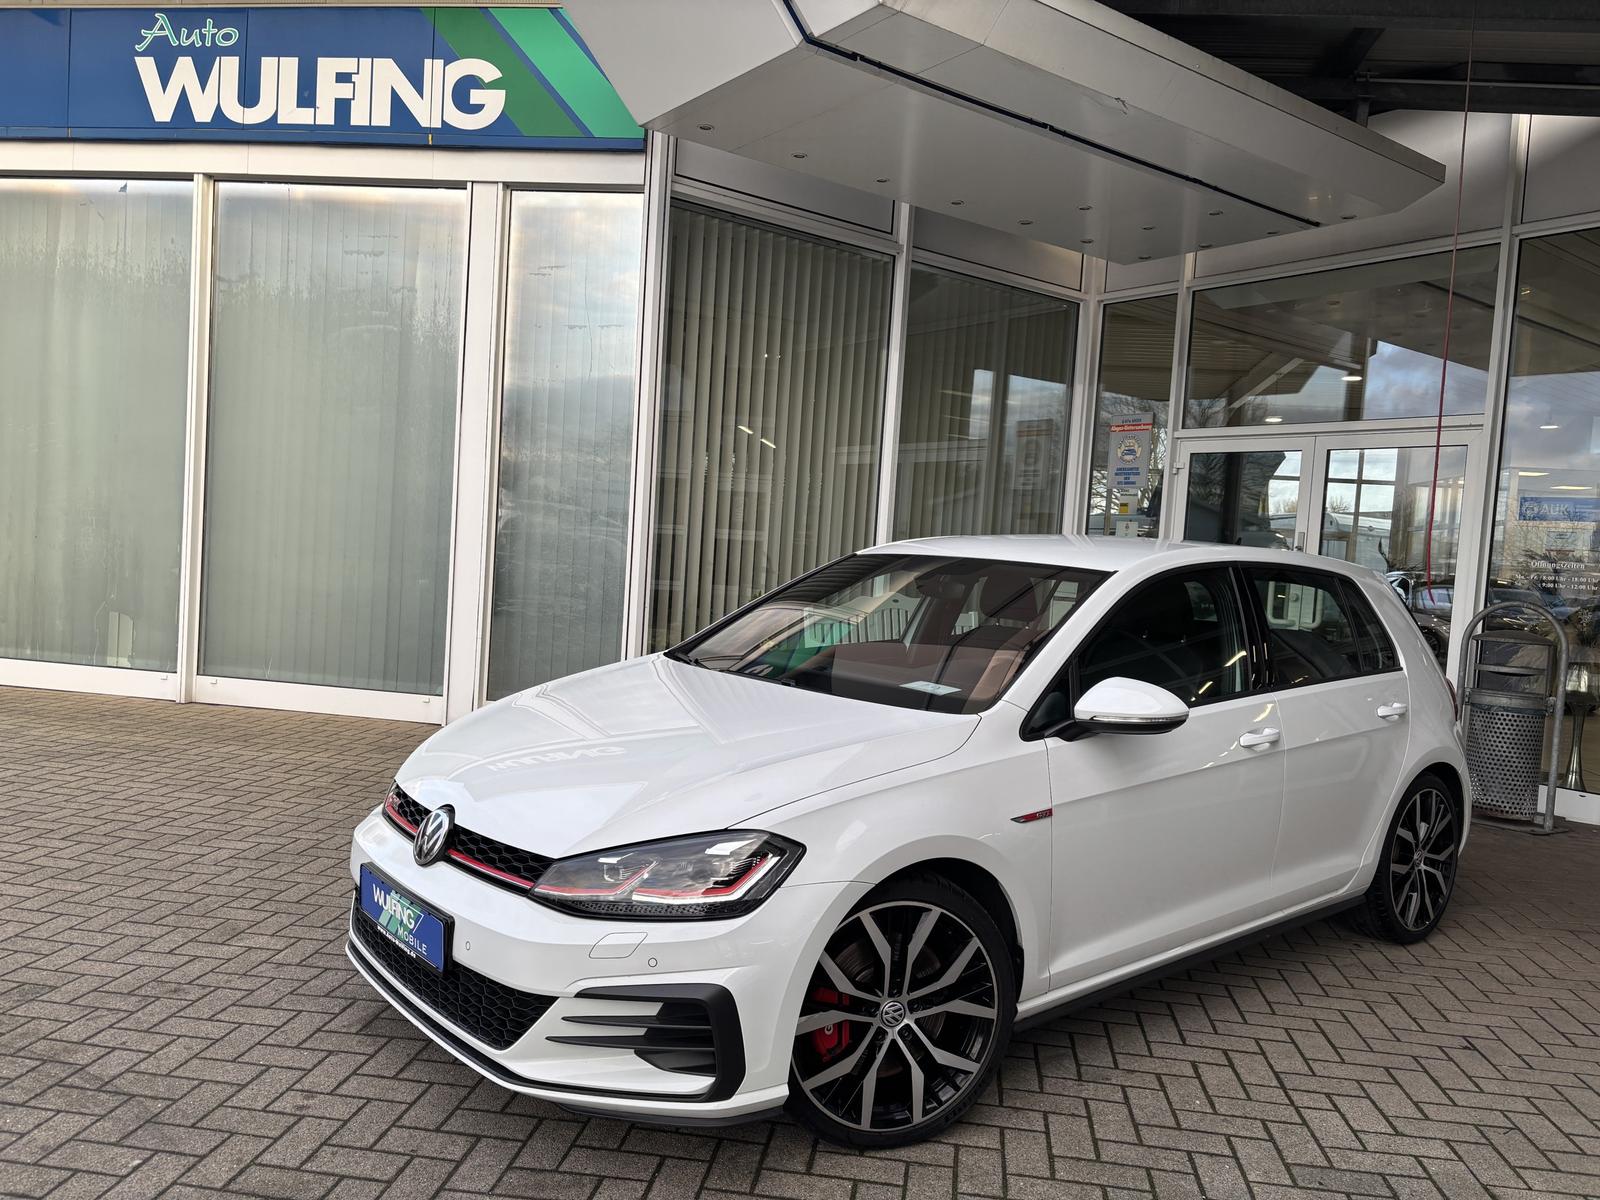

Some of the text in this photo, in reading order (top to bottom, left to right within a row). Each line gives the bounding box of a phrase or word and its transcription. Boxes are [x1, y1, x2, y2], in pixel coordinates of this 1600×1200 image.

[134, 12, 240, 52] Auto
[133, 55, 507, 131] WULFING
[372, 883, 415, 929] WULFING
[397, 923, 428, 956] MOBILE
